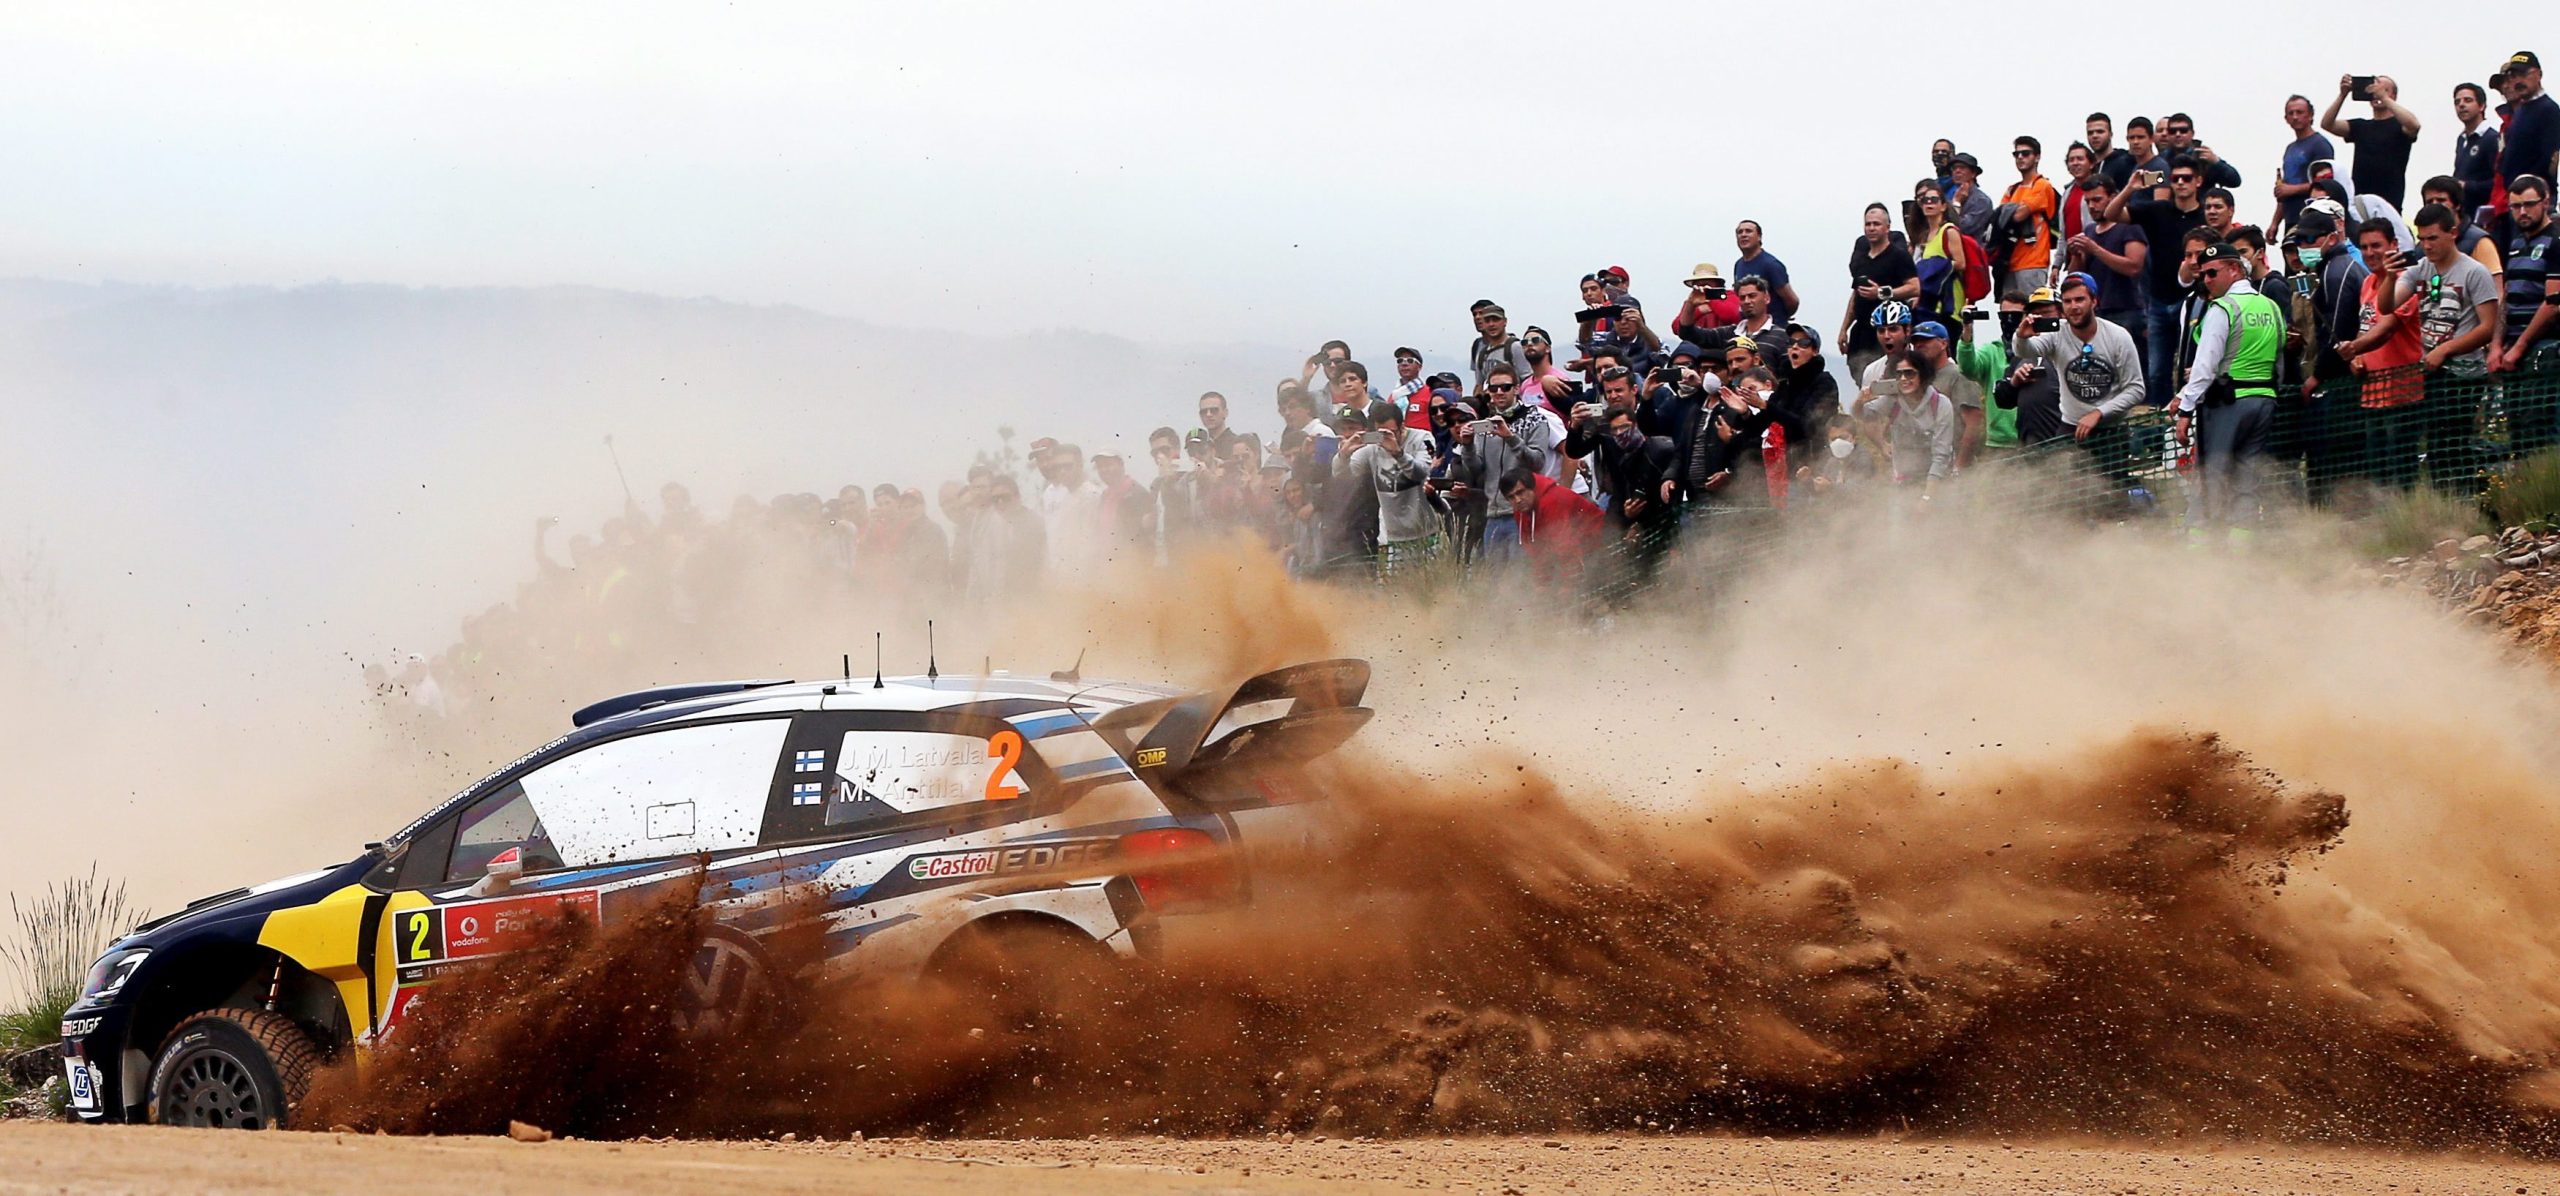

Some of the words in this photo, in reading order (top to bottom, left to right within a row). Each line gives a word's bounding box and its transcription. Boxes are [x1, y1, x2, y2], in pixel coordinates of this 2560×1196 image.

[2245, 312, 2274, 327] GNR
[866, 748, 892, 769] M.
[899, 742, 985, 768] Latvala
[984, 730, 1022, 800] 2
[1137, 750, 1167, 765] OMP
[395, 736, 568, 840] www.volkswagen-motorsport.com
[839, 780, 871, 803] M.
[880, 777, 964, 802] Anttila
[929, 853, 995, 877] Castrol
[409, 912, 431, 960] 2
[451, 936, 490, 948] vodafone
